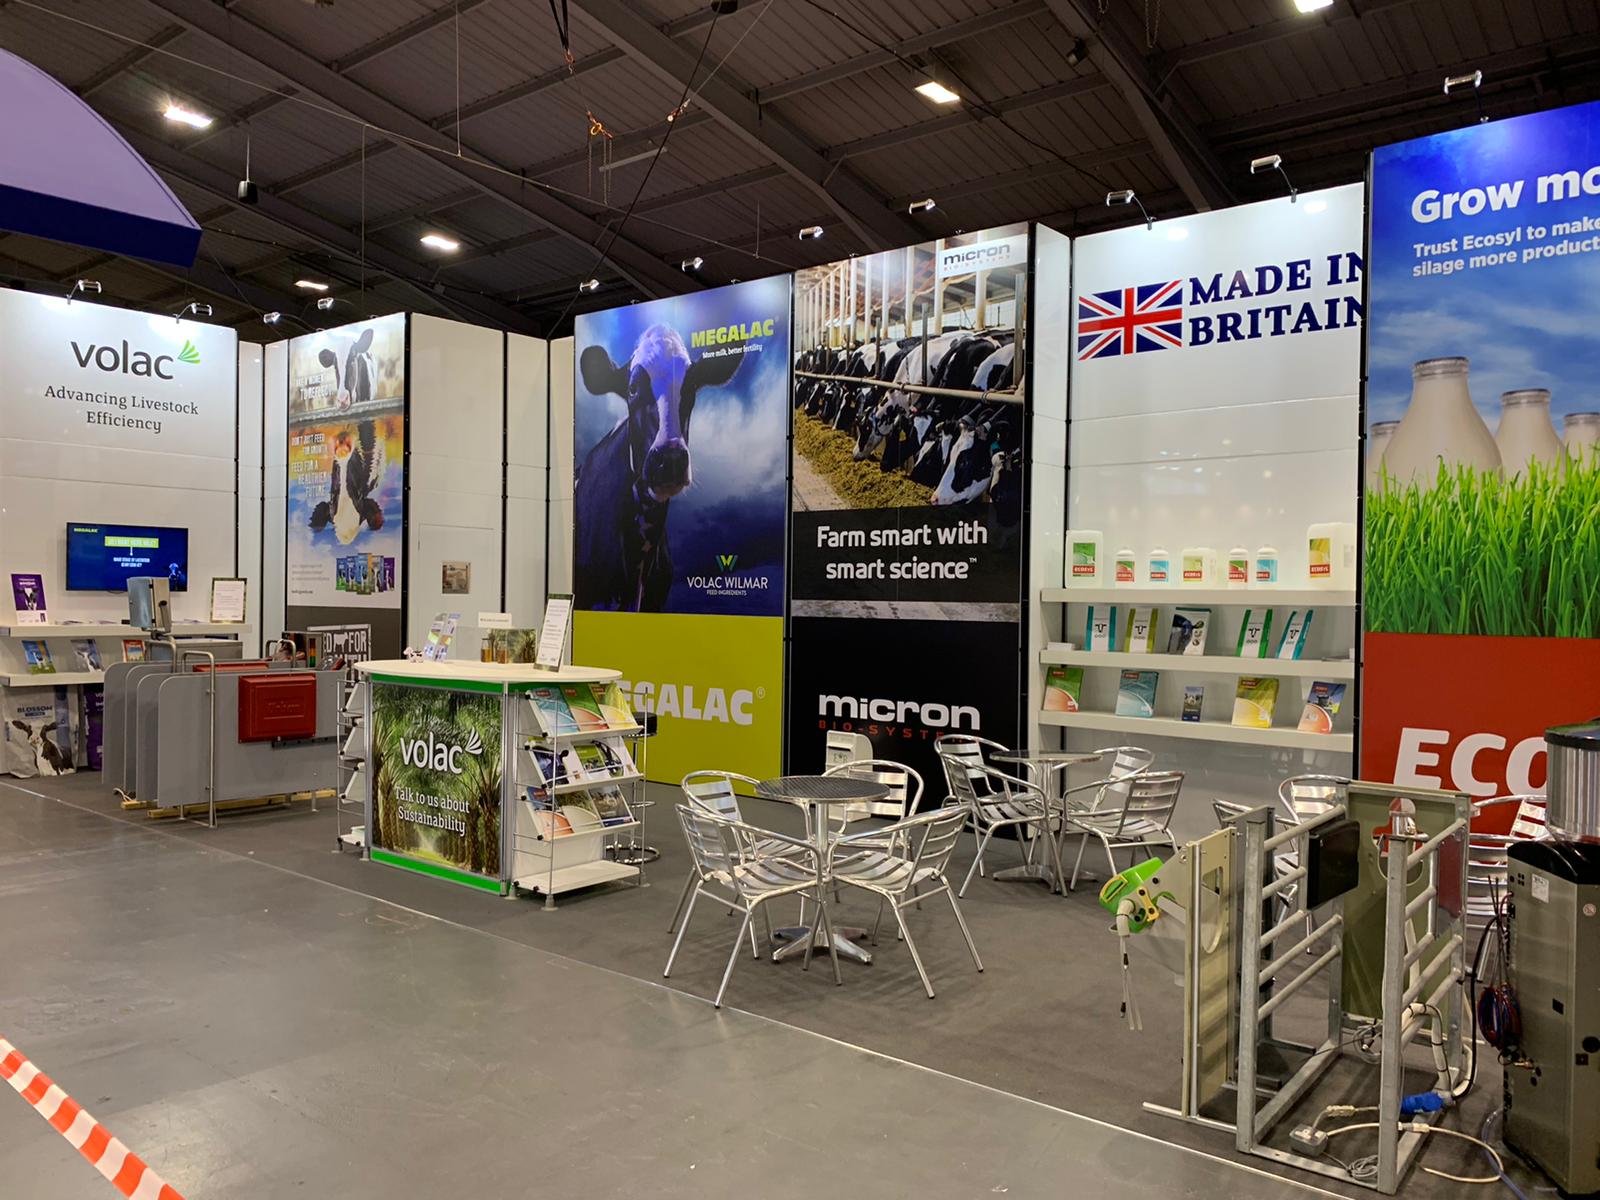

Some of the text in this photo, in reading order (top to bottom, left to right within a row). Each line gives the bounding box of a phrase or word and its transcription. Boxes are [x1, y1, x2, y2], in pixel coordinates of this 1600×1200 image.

[1411, 180, 1524, 224] Grow
[944, 244, 1010, 265] micron
[1413, 238, 1458, 258] Trust
[1463, 227, 1522, 250] Ecosyl
[1527, 225, 1547, 240] to
[1412, 258, 1465, 277] silage
[1469, 250, 1518, 269] more
[1189, 251, 1363, 306] MADE IN
[691, 319, 774, 348] MEGALAC
[1189, 296, 1363, 347] BRITAIN
[70, 339, 174, 380] volac
[45, 385, 199, 415] Advancing Livestock
[86, 411, 162, 434] Efficiency
[817, 520, 988, 548] Farm smart with
[686, 576, 769, 589] VOLAC WILMAR
[826, 559, 885, 579] smart
[348, 630, 367, 653] FOR
[818, 694, 981, 731] micron
[818, 719, 965, 743] BIO-SYSTE
[400, 732, 463, 774] volac
[395, 785, 470, 814] Talk to us about
[398, 806, 466, 837] Sustainability
